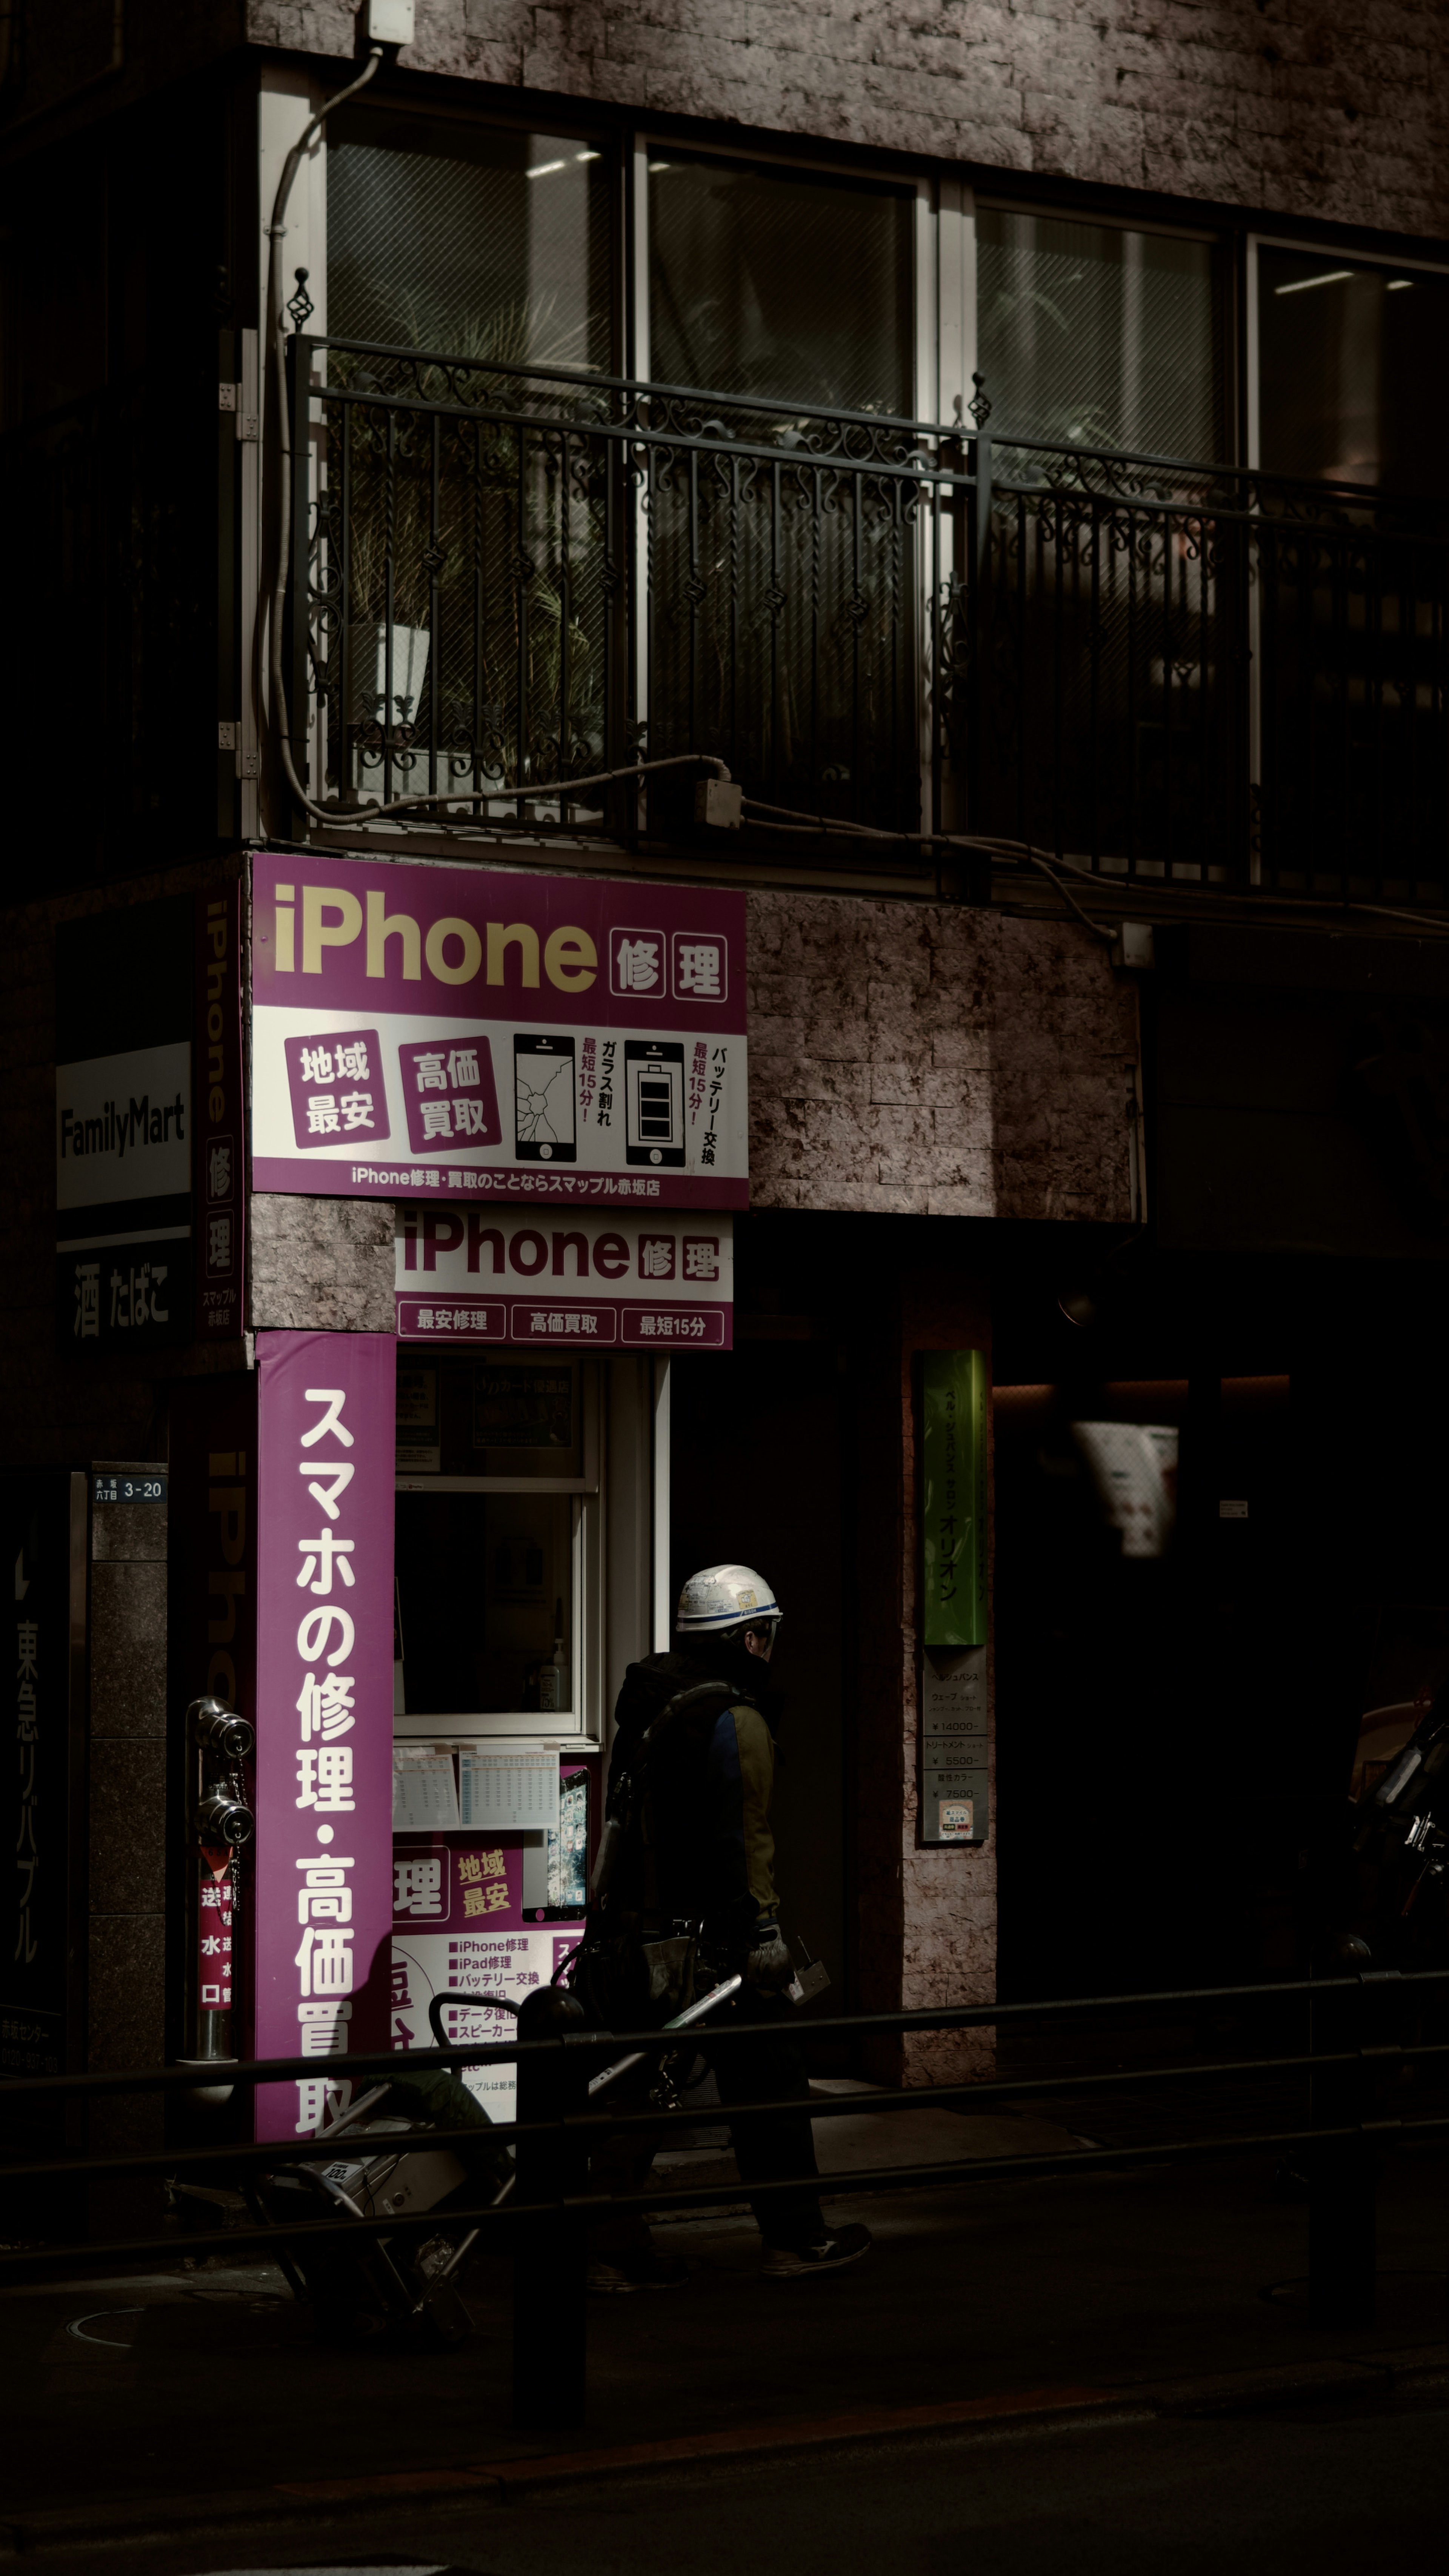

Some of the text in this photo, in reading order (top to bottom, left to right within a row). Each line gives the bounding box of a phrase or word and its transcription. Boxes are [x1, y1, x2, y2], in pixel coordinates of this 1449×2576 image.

[275, 884, 720, 996] iPhone 修理
[300, 1041, 370, 1084] 地域
[414, 1049, 481, 1093] 高価
[206, 900, 231, 1269] iPhone 修理
[597, 1041, 617, 1127] ガラス割れ
[306, 1091, 375, 1135] 最安
[420, 1098, 488, 1141] 買取
[701, 1048, 727, 1166] バッテリー交換
[62, 1093, 185, 1159] FamilyMart
[352, 1166, 660, 1197] iPhone修理・買取のことならスマップル赤坂店
[404, 1210, 715, 1279] iPhone 修理
[73, 1260, 169, 1339] 酒 たばこ
[202, 1292, 237, 1307] スマップル
[208, 1310, 230, 1326] 赤坂店
[418, 1310, 488, 1331] 最安修理
[531, 1312, 598, 1334] 高価買取
[640, 1316, 706, 1337] 最短15分
[96, 1479, 117, 1489] 赤坂
[96, 1490, 117, 1500] 六丁目
[125, 1482, 162, 1497] 3-20
[946, 1479, 956, 1510] サロン
[941, 1515, 957, 1601] オリオン
[295, 1389, 356, 2139] スマホの修理・高価買取
[14, 1618, 39, 1963] 東急リバブル
[458, 1848, 506, 1882] 地域
[463, 1882, 509, 1915] 最安
[201, 1887, 222, 2003] 送水口
[459, 1939, 529, 1952] iPhone修理
[459, 1956, 512, 1970] iPad修理
[459, 1972, 540, 1987] バッテリー交換
[2, 2017, 49, 2044] 赤坂センター
